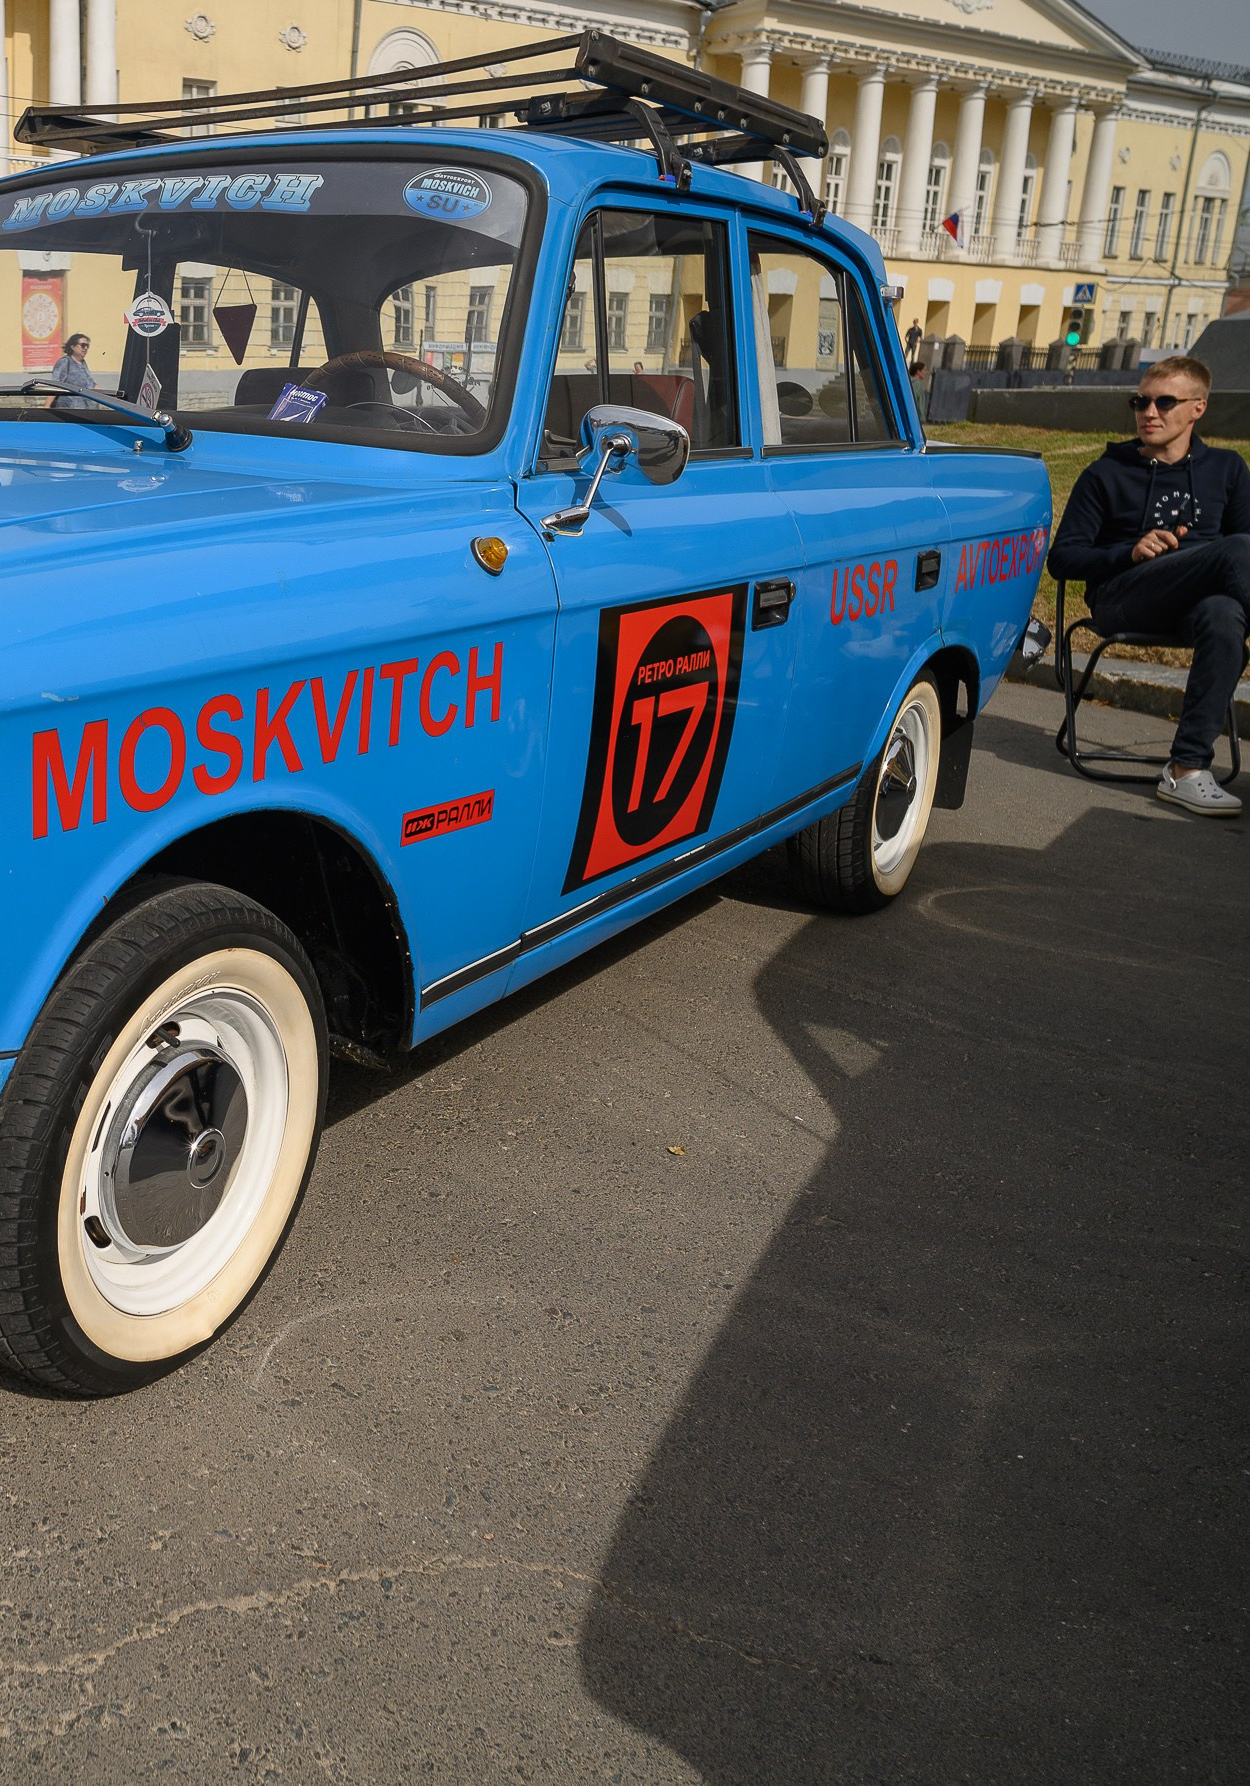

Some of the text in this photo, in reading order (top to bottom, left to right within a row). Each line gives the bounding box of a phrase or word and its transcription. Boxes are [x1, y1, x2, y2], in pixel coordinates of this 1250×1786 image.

[1, 173, 325, 231] MOSKVICH
[421, 178, 480, 198] MOSKVICH
[426, 195, 460, 213] SU
[831, 559, 898, 626] USSR
[638, 650, 711, 686] РЕТРО РАЛЛИ
[33, 642, 504, 840] MOSKVITCH
[627, 681, 709, 813] 17
[436, 796, 492, 829] РАЛЛИ
